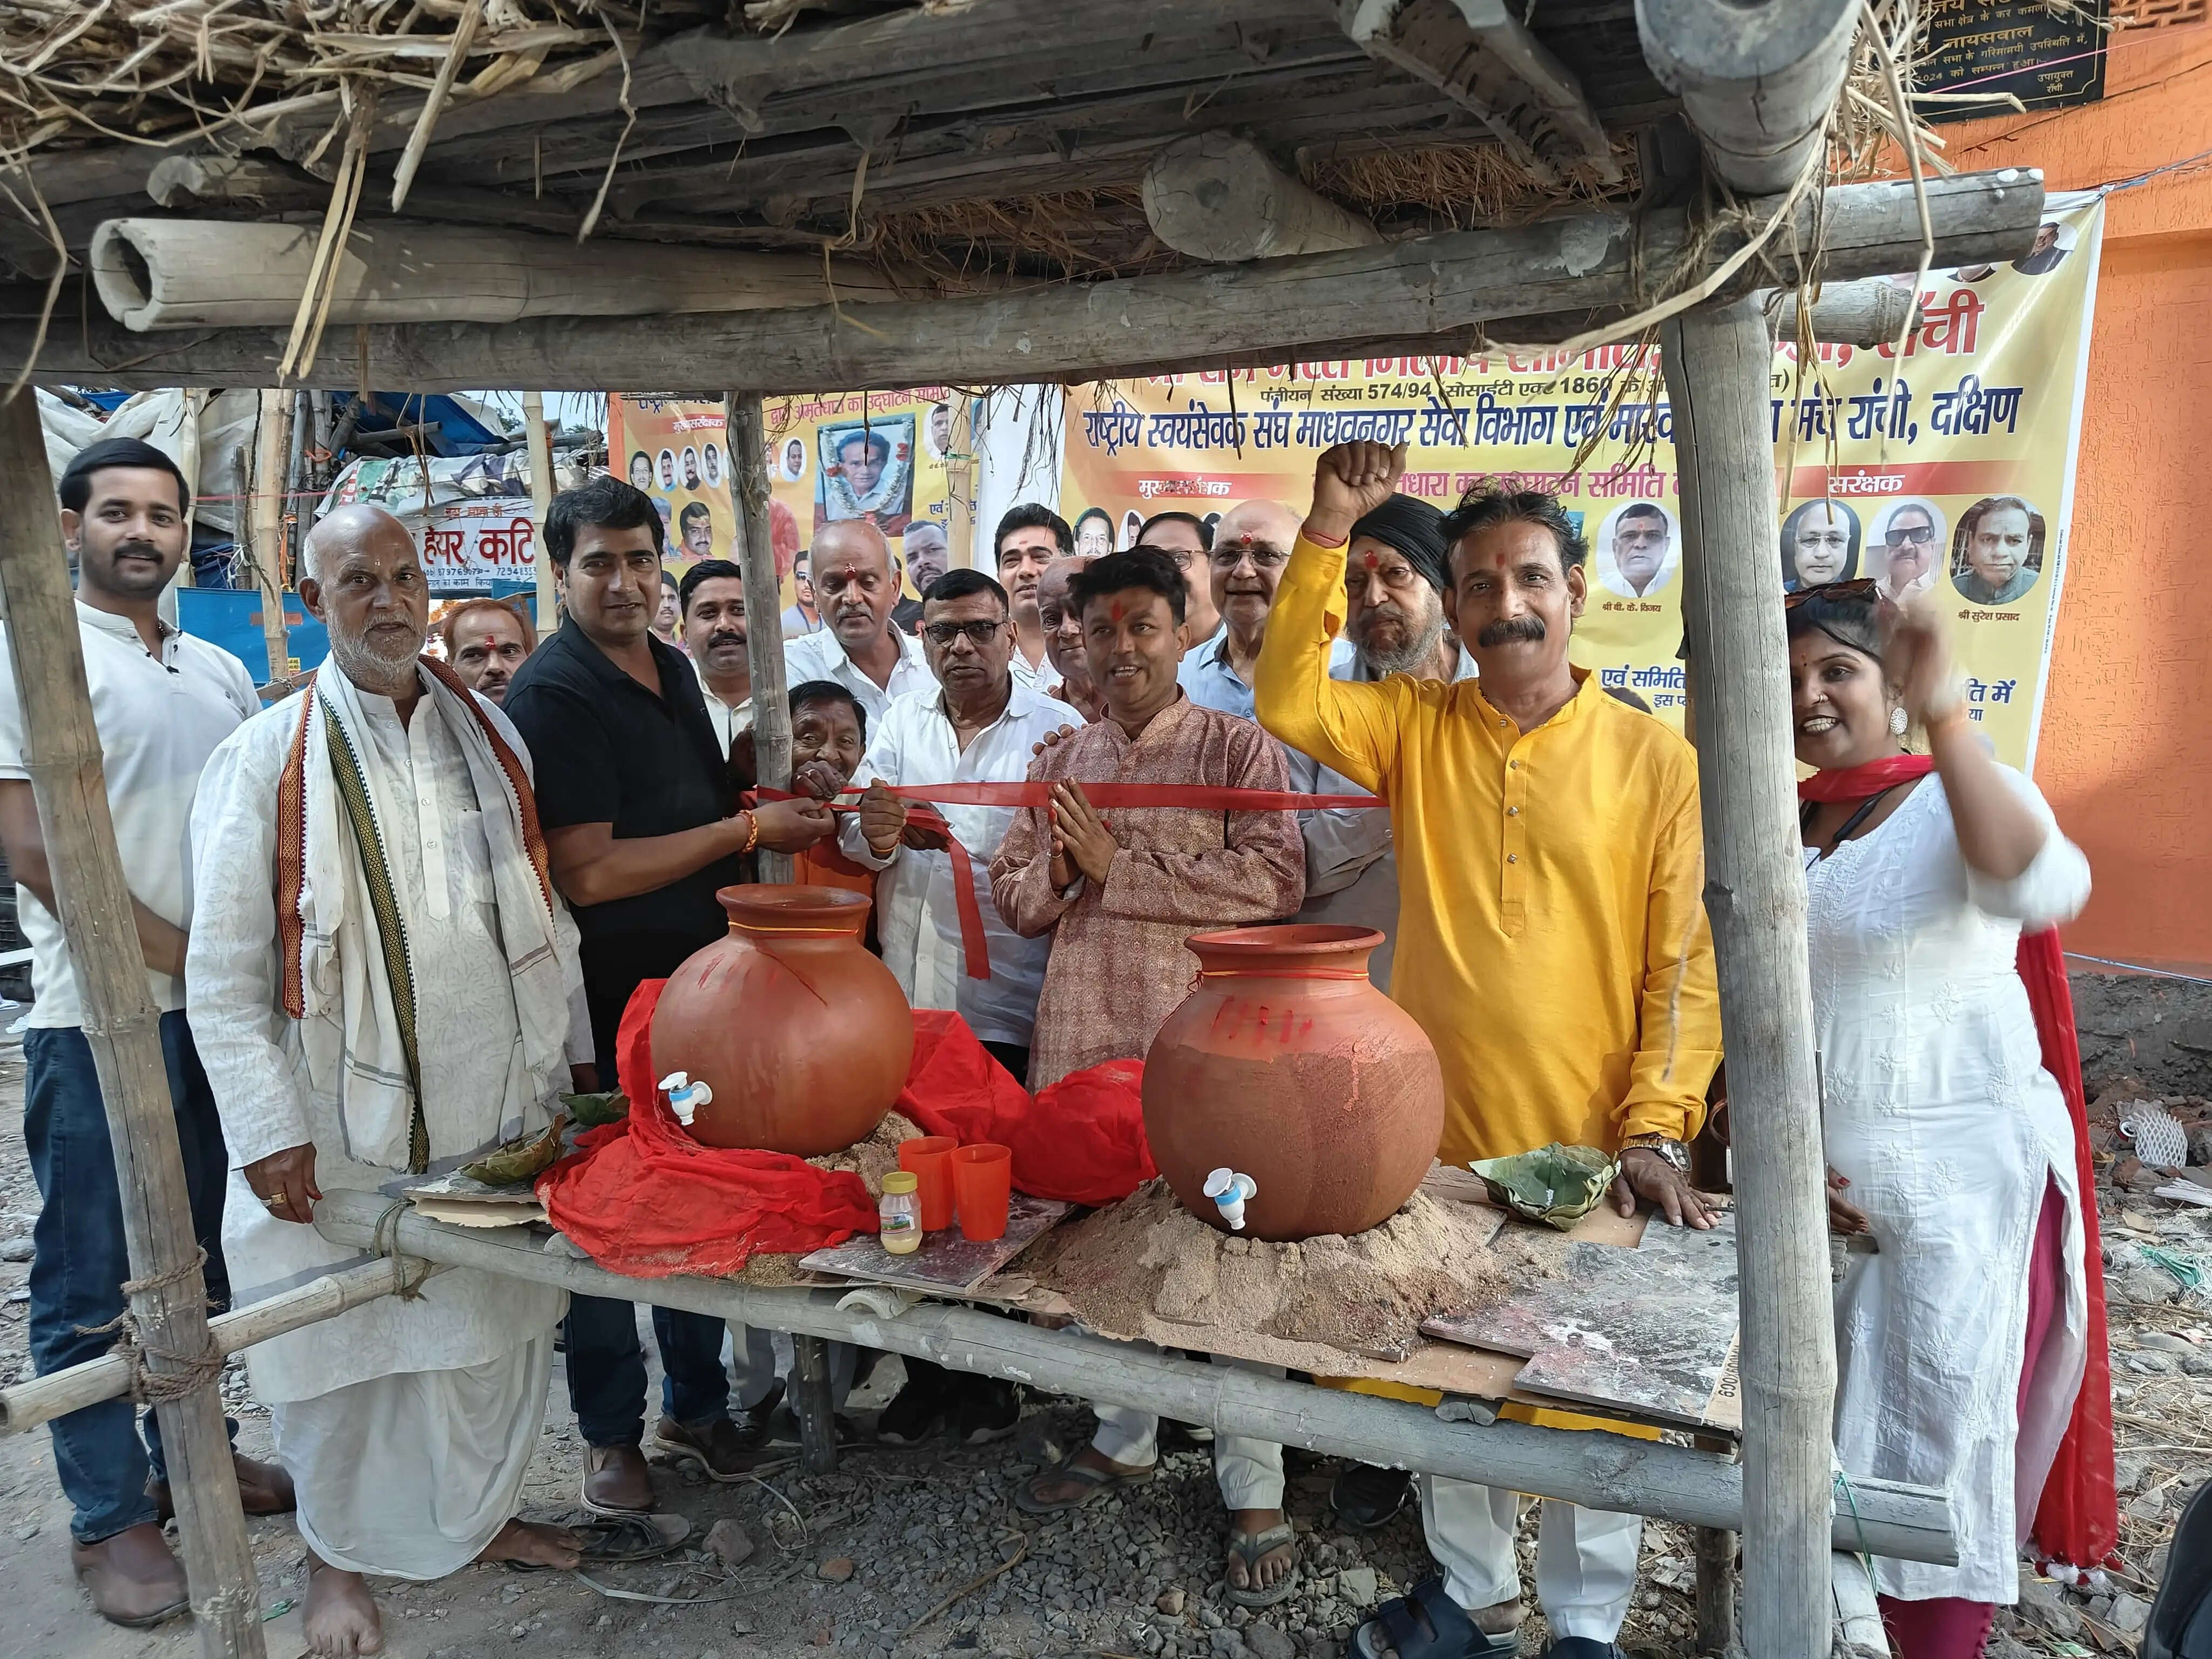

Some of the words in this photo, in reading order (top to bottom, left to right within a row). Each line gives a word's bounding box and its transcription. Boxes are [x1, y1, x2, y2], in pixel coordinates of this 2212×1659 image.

[1980, 10, 1990, 22] के
[1966, 50, 1974, 60] के
[1950, 66, 1964, 78] को
[1321, 384, 1363, 401] संख्या
[1368, 382, 1432, 400] 574/94
[847, 396, 864, 413] का
[1083, 401, 1145, 456] राष्ट्रीय
[1148, 399, 1249, 449] स्वयंसेवक
[1254, 397, 1293, 448] संघ
[1297, 409, 1417, 448] माधवनगर
[1420, 393, 1470, 447] सेवा
[1474, 393, 1559, 446] विभाग
[1565, 388, 1609, 448] एवं
[1847, 376, 1918, 446] रांची,
[1931, 374, 2024, 435] दक्षिण
[1588, 463, 1667, 498] समिति
[479, 517, 536, 565] कटि
[1602, 602, 1613, 611] श्री
[1958, 609, 1971, 620] श्री
[1972, 610, 1993, 622] सुरेश
[1995, 612, 2020, 621] प्रसाद
[1601, 664, 1630, 686] एवं
[1992, 679, 2017, 704] में
[1654, 694, 1674, 708] इस
